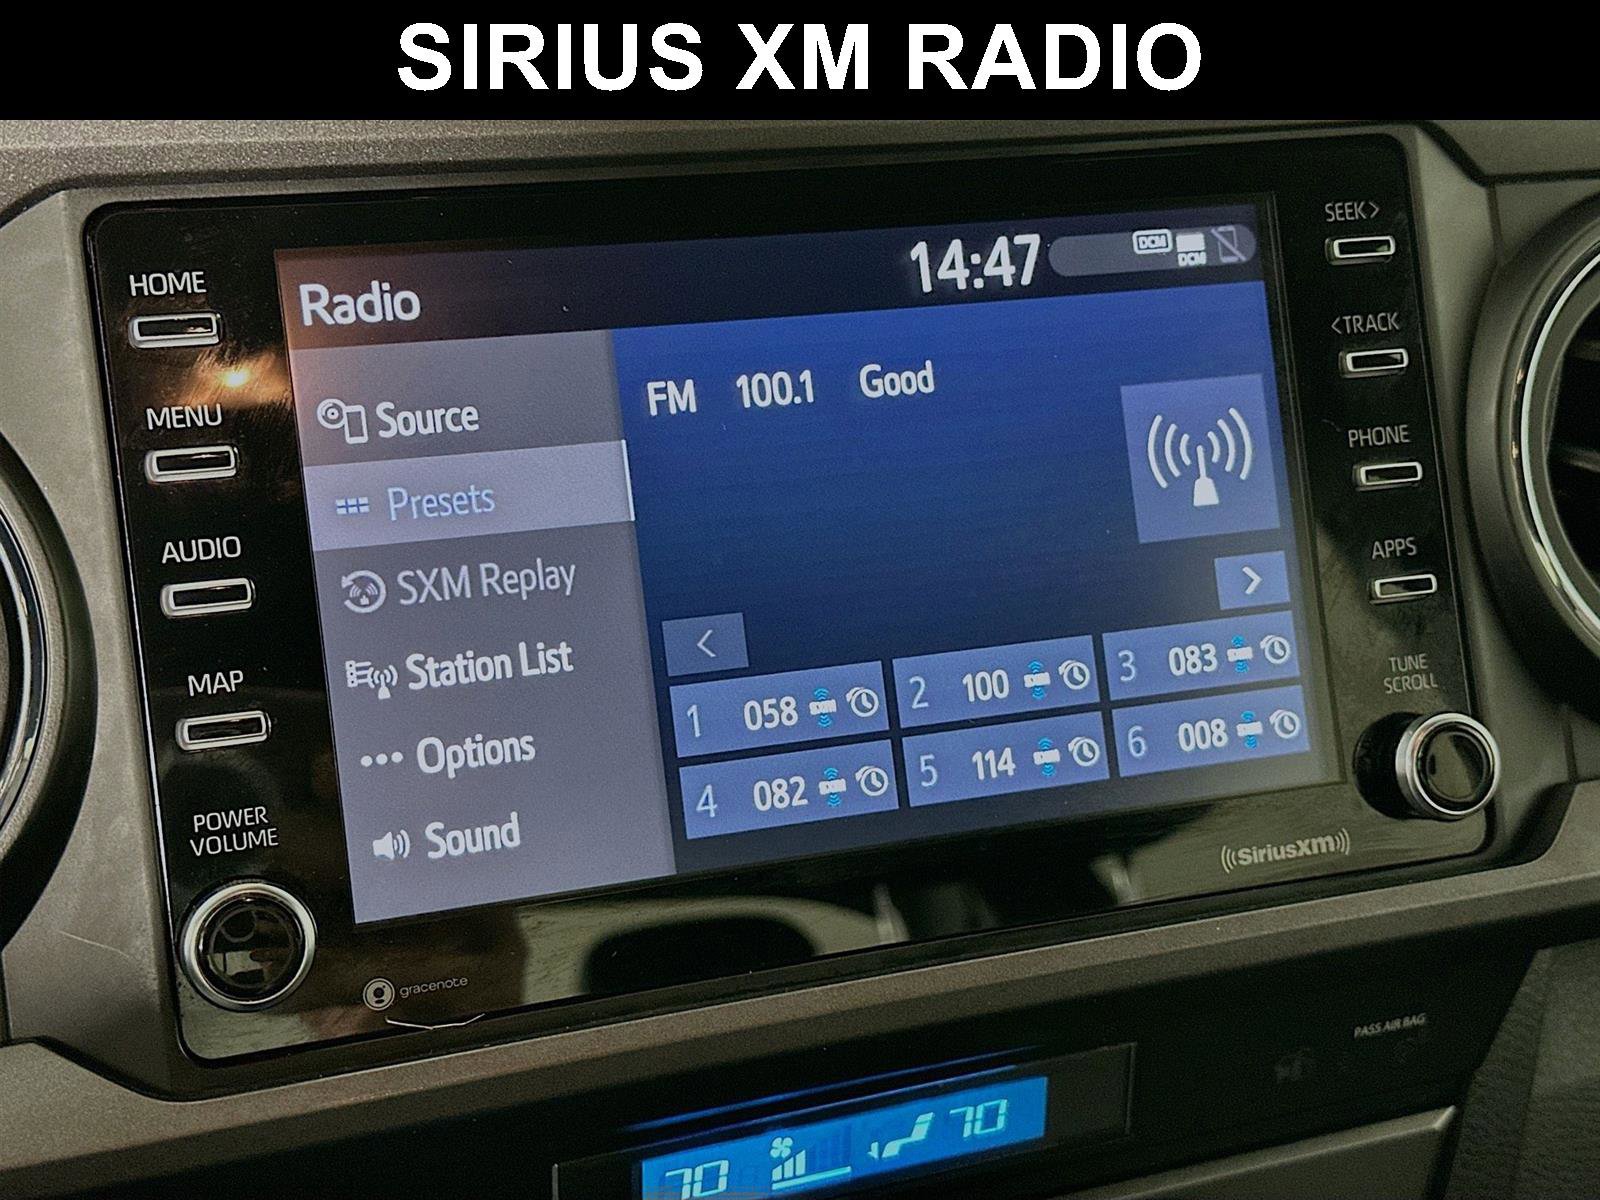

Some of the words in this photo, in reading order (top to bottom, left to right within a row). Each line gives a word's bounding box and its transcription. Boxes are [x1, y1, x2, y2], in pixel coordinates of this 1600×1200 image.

[910, 233, 1041, 293] 14:47
[128, 271, 207, 297] HOME
[299, 281, 421, 326] Radio
[647, 379, 697, 416] FM
[736, 369, 815, 409] 100.1
[859, 360, 935, 399] Good
[146, 403, 222, 430] MENU
[375, 402, 480, 438] Source
[1348, 424, 1411, 449] PHONE
[387, 483, 496, 520] Presets
[161, 535, 242, 564] AUDIO
[1371, 537, 1417, 560] APPS
[396, 563, 472, 606] SXM
[479, 557, 577, 601] Replay
[405, 650, 513, 690] Station
[518, 641, 575, 677] List
[1117, 649, 1136, 682] 3
[1168, 643, 1218, 677] 083
[1388, 653, 1428, 673] TUNE
[187, 669, 244, 697] MAP
[909, 676, 929, 709] 2
[962, 669, 1010, 702] 100
[1383, 672, 1438, 695] SCROLL
[686, 704, 701, 738] 1
[743, 696, 799, 731] 058
[416, 733, 536, 779] Options
[1127, 725, 1147, 759] 6
[1177, 718, 1228, 752] 008
[919, 754, 938, 788] 5
[972, 747, 1016, 781] 114
[696, 784, 718, 818] 4
[753, 776, 809, 812] 082
[193, 806, 269, 832] POWER
[424, 811, 521, 859] Sound
[190, 827, 279, 857] VOLUME
[400, 977, 468, 999] gracenote
[1354, 1022, 1382, 1039] PASS
[1402, 1013, 1427, 1029] BAG
[949, 1099, 1008, 1138] 70
[665, 1160, 730, 1200] 70
